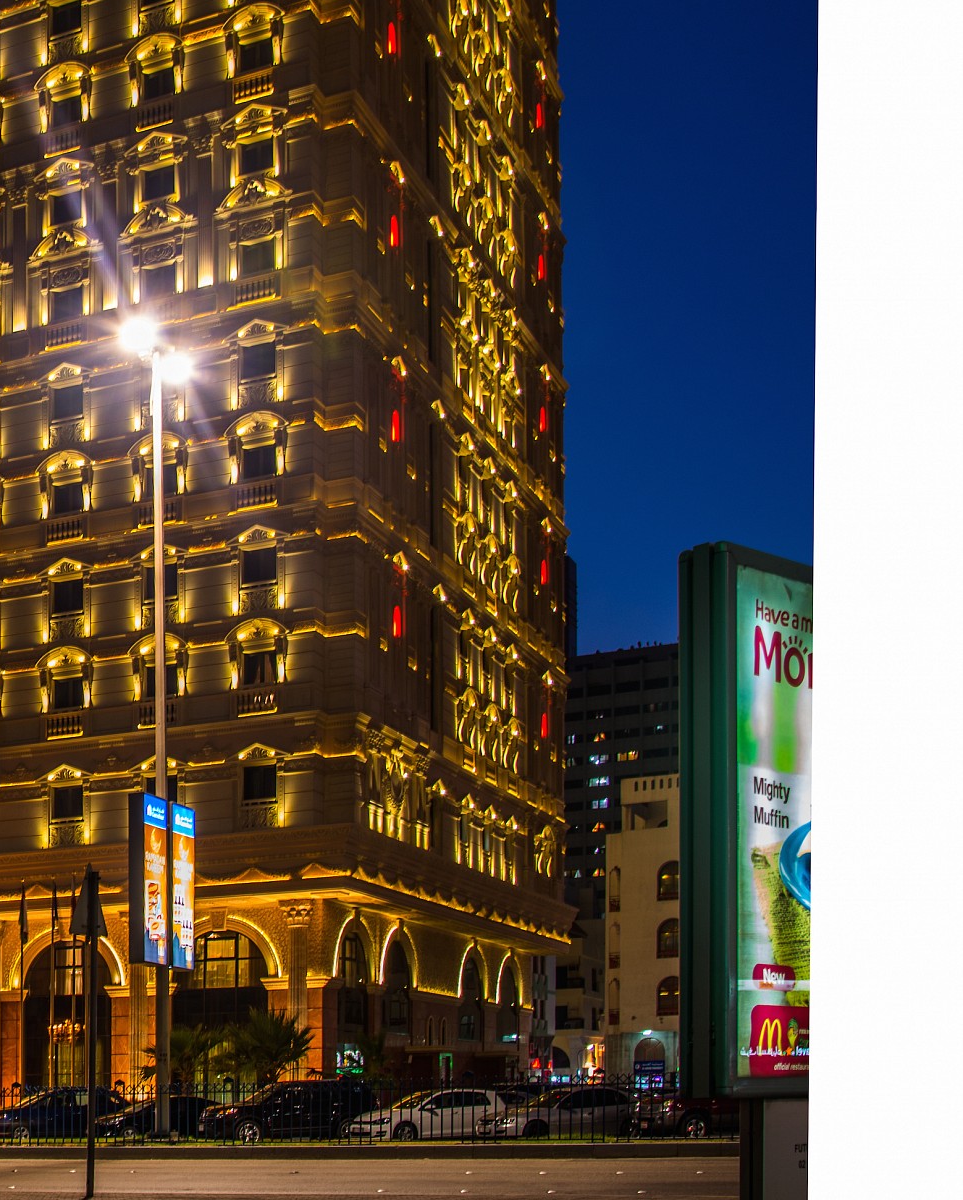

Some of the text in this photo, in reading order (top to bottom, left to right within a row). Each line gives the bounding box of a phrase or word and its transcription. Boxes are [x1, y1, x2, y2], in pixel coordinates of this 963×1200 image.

[755, 598, 790, 627] Have
[791, 613, 799, 630] a
[753, 775, 791, 804] Mighty
[753, 805, 790, 829] Muffin
[762, 967, 786, 985] New
